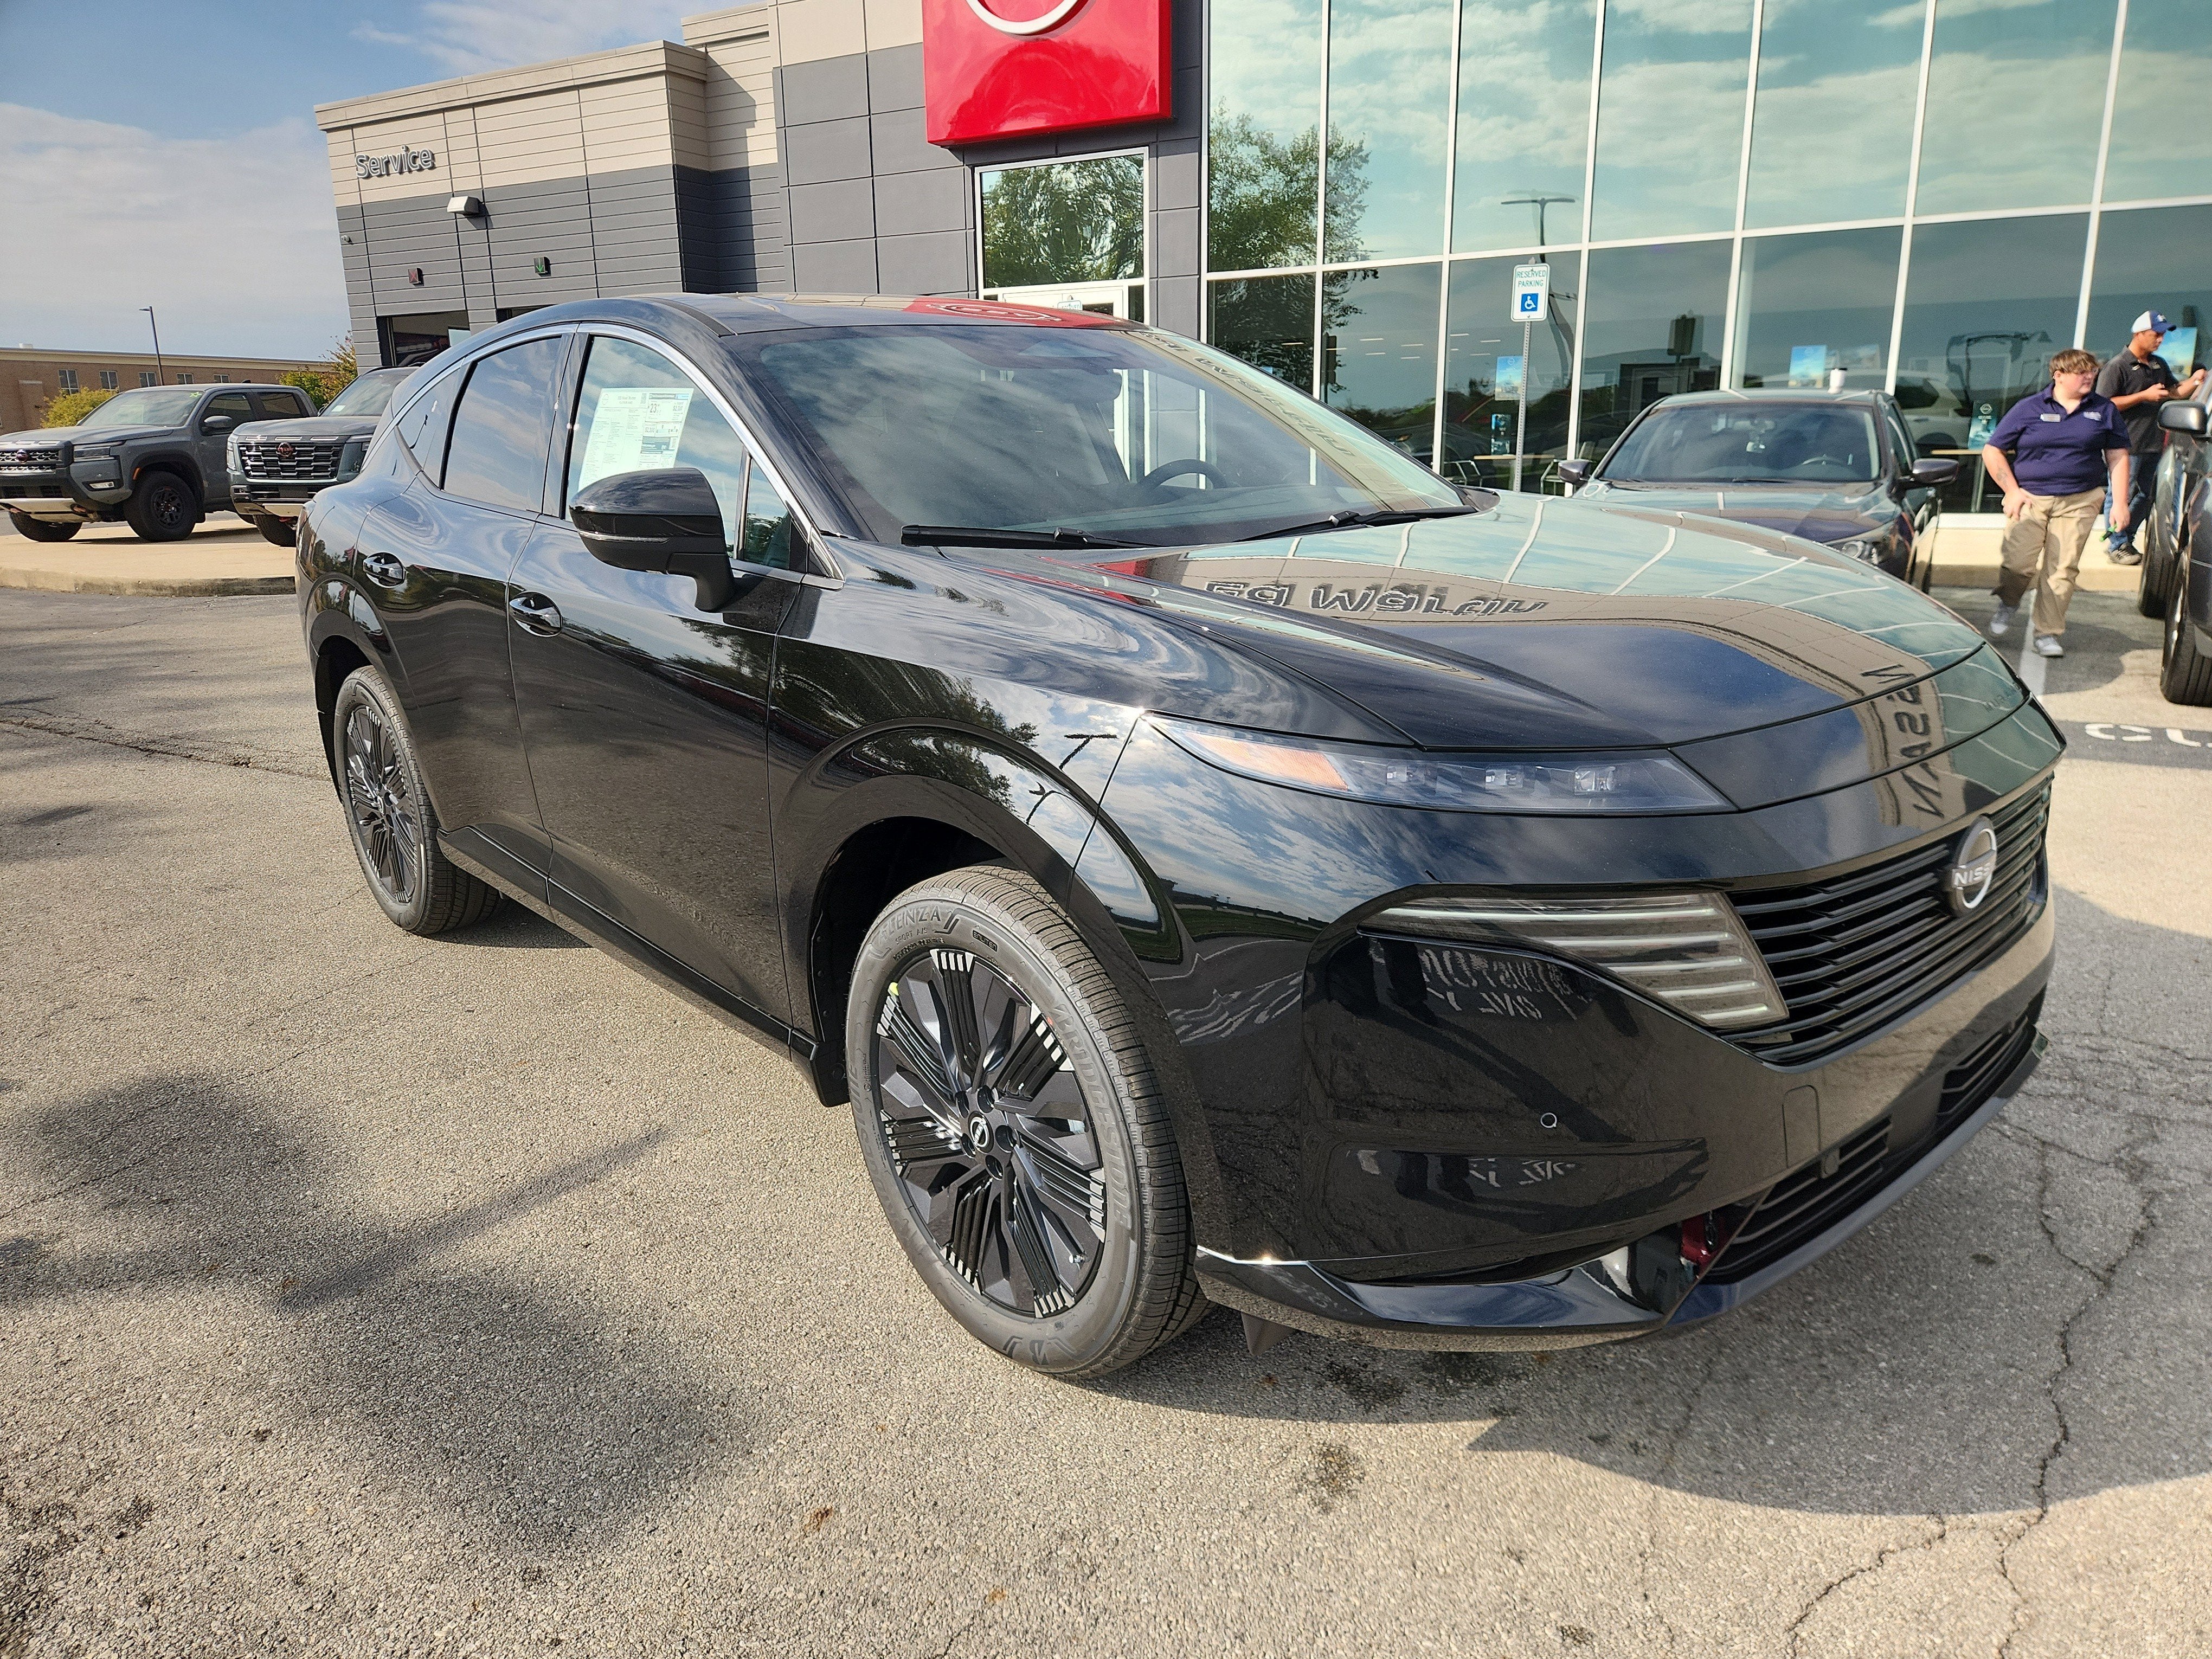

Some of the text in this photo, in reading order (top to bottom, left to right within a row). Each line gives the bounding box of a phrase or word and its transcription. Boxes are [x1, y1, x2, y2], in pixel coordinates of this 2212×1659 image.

[355, 145, 433, 178] Service
[1516, 270, 1546, 278] RESERVED
[895, 930, 913, 945] SPORT
[1051, 1002, 1133, 1231] BRIDGESTONE
